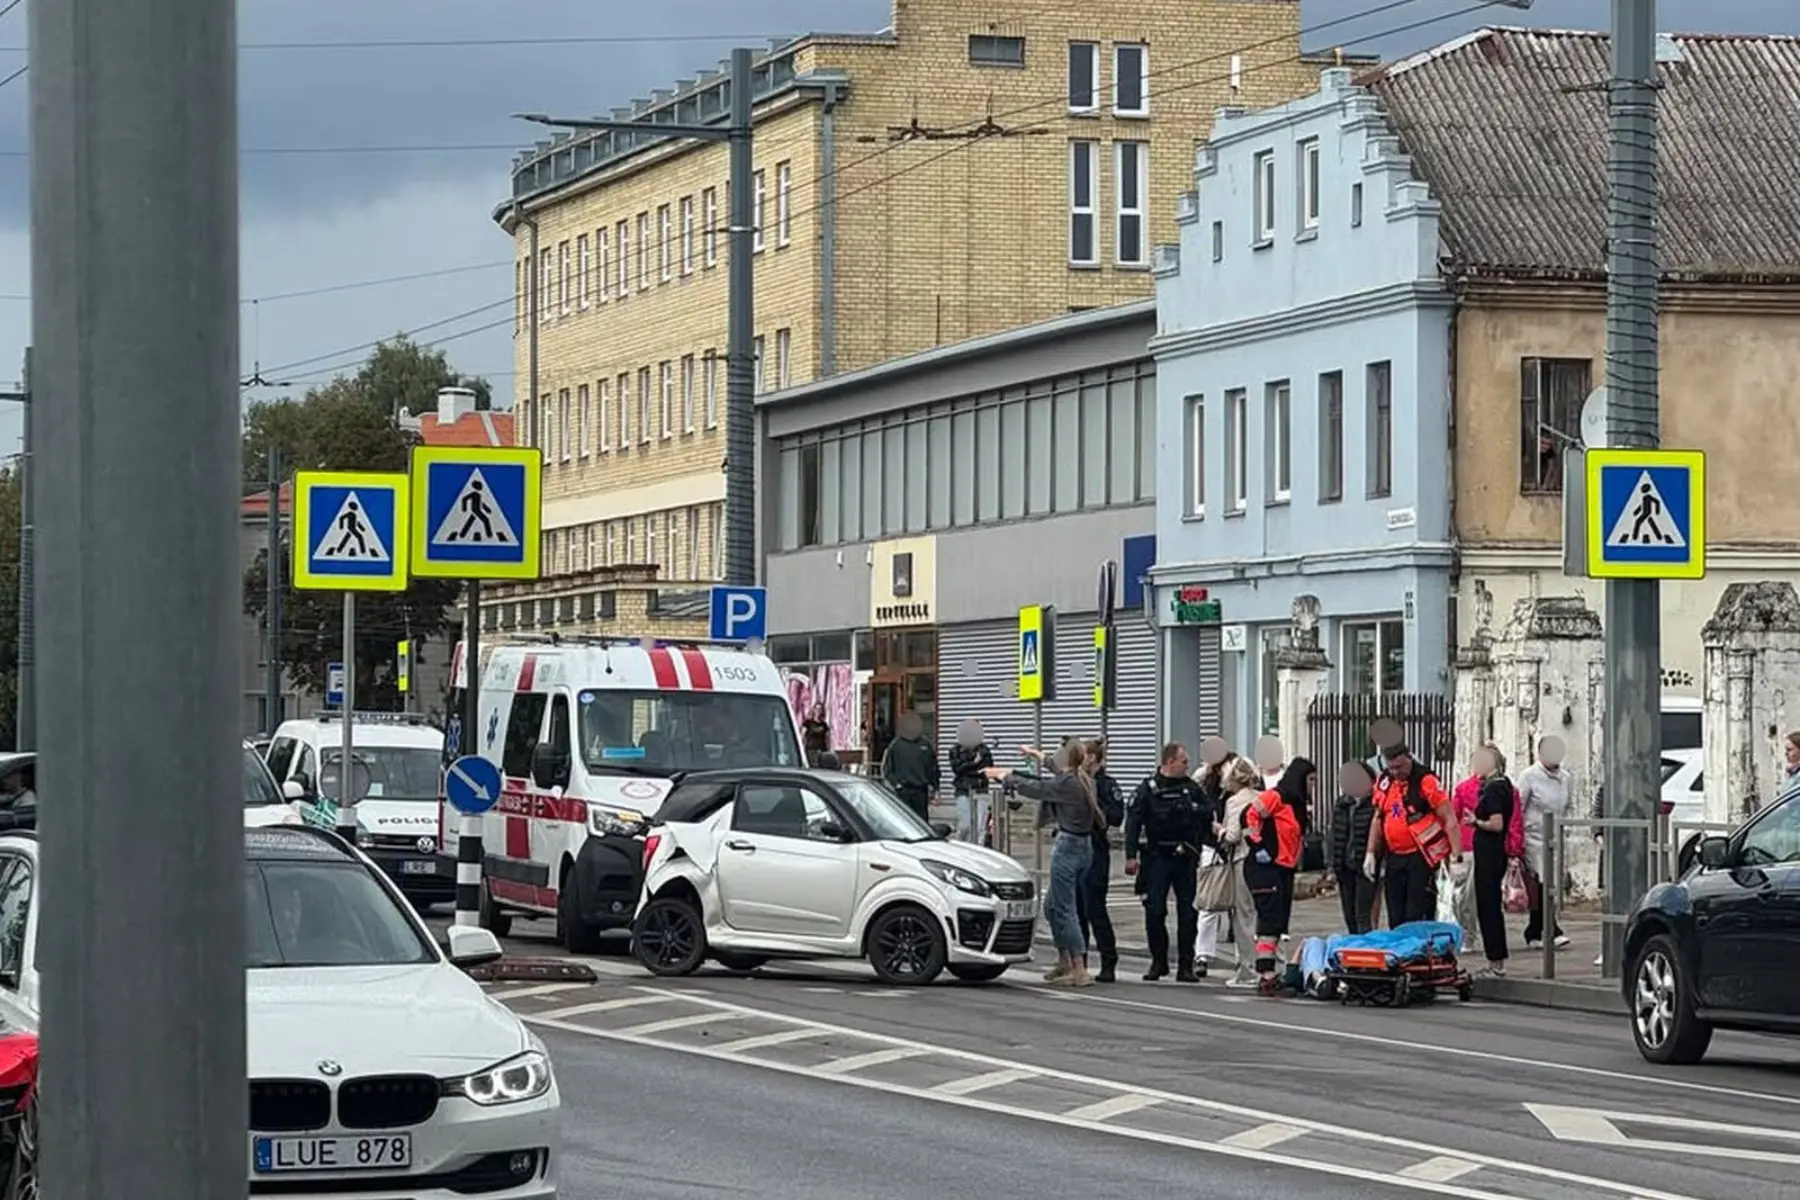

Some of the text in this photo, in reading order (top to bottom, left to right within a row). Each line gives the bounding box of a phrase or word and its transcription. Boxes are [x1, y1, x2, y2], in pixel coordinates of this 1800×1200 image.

[726, 593, 757, 637] P
[714, 666, 757, 682] 1503
[276, 1140, 337, 1166] LUE
[357, 1138, 405, 1164] 878
